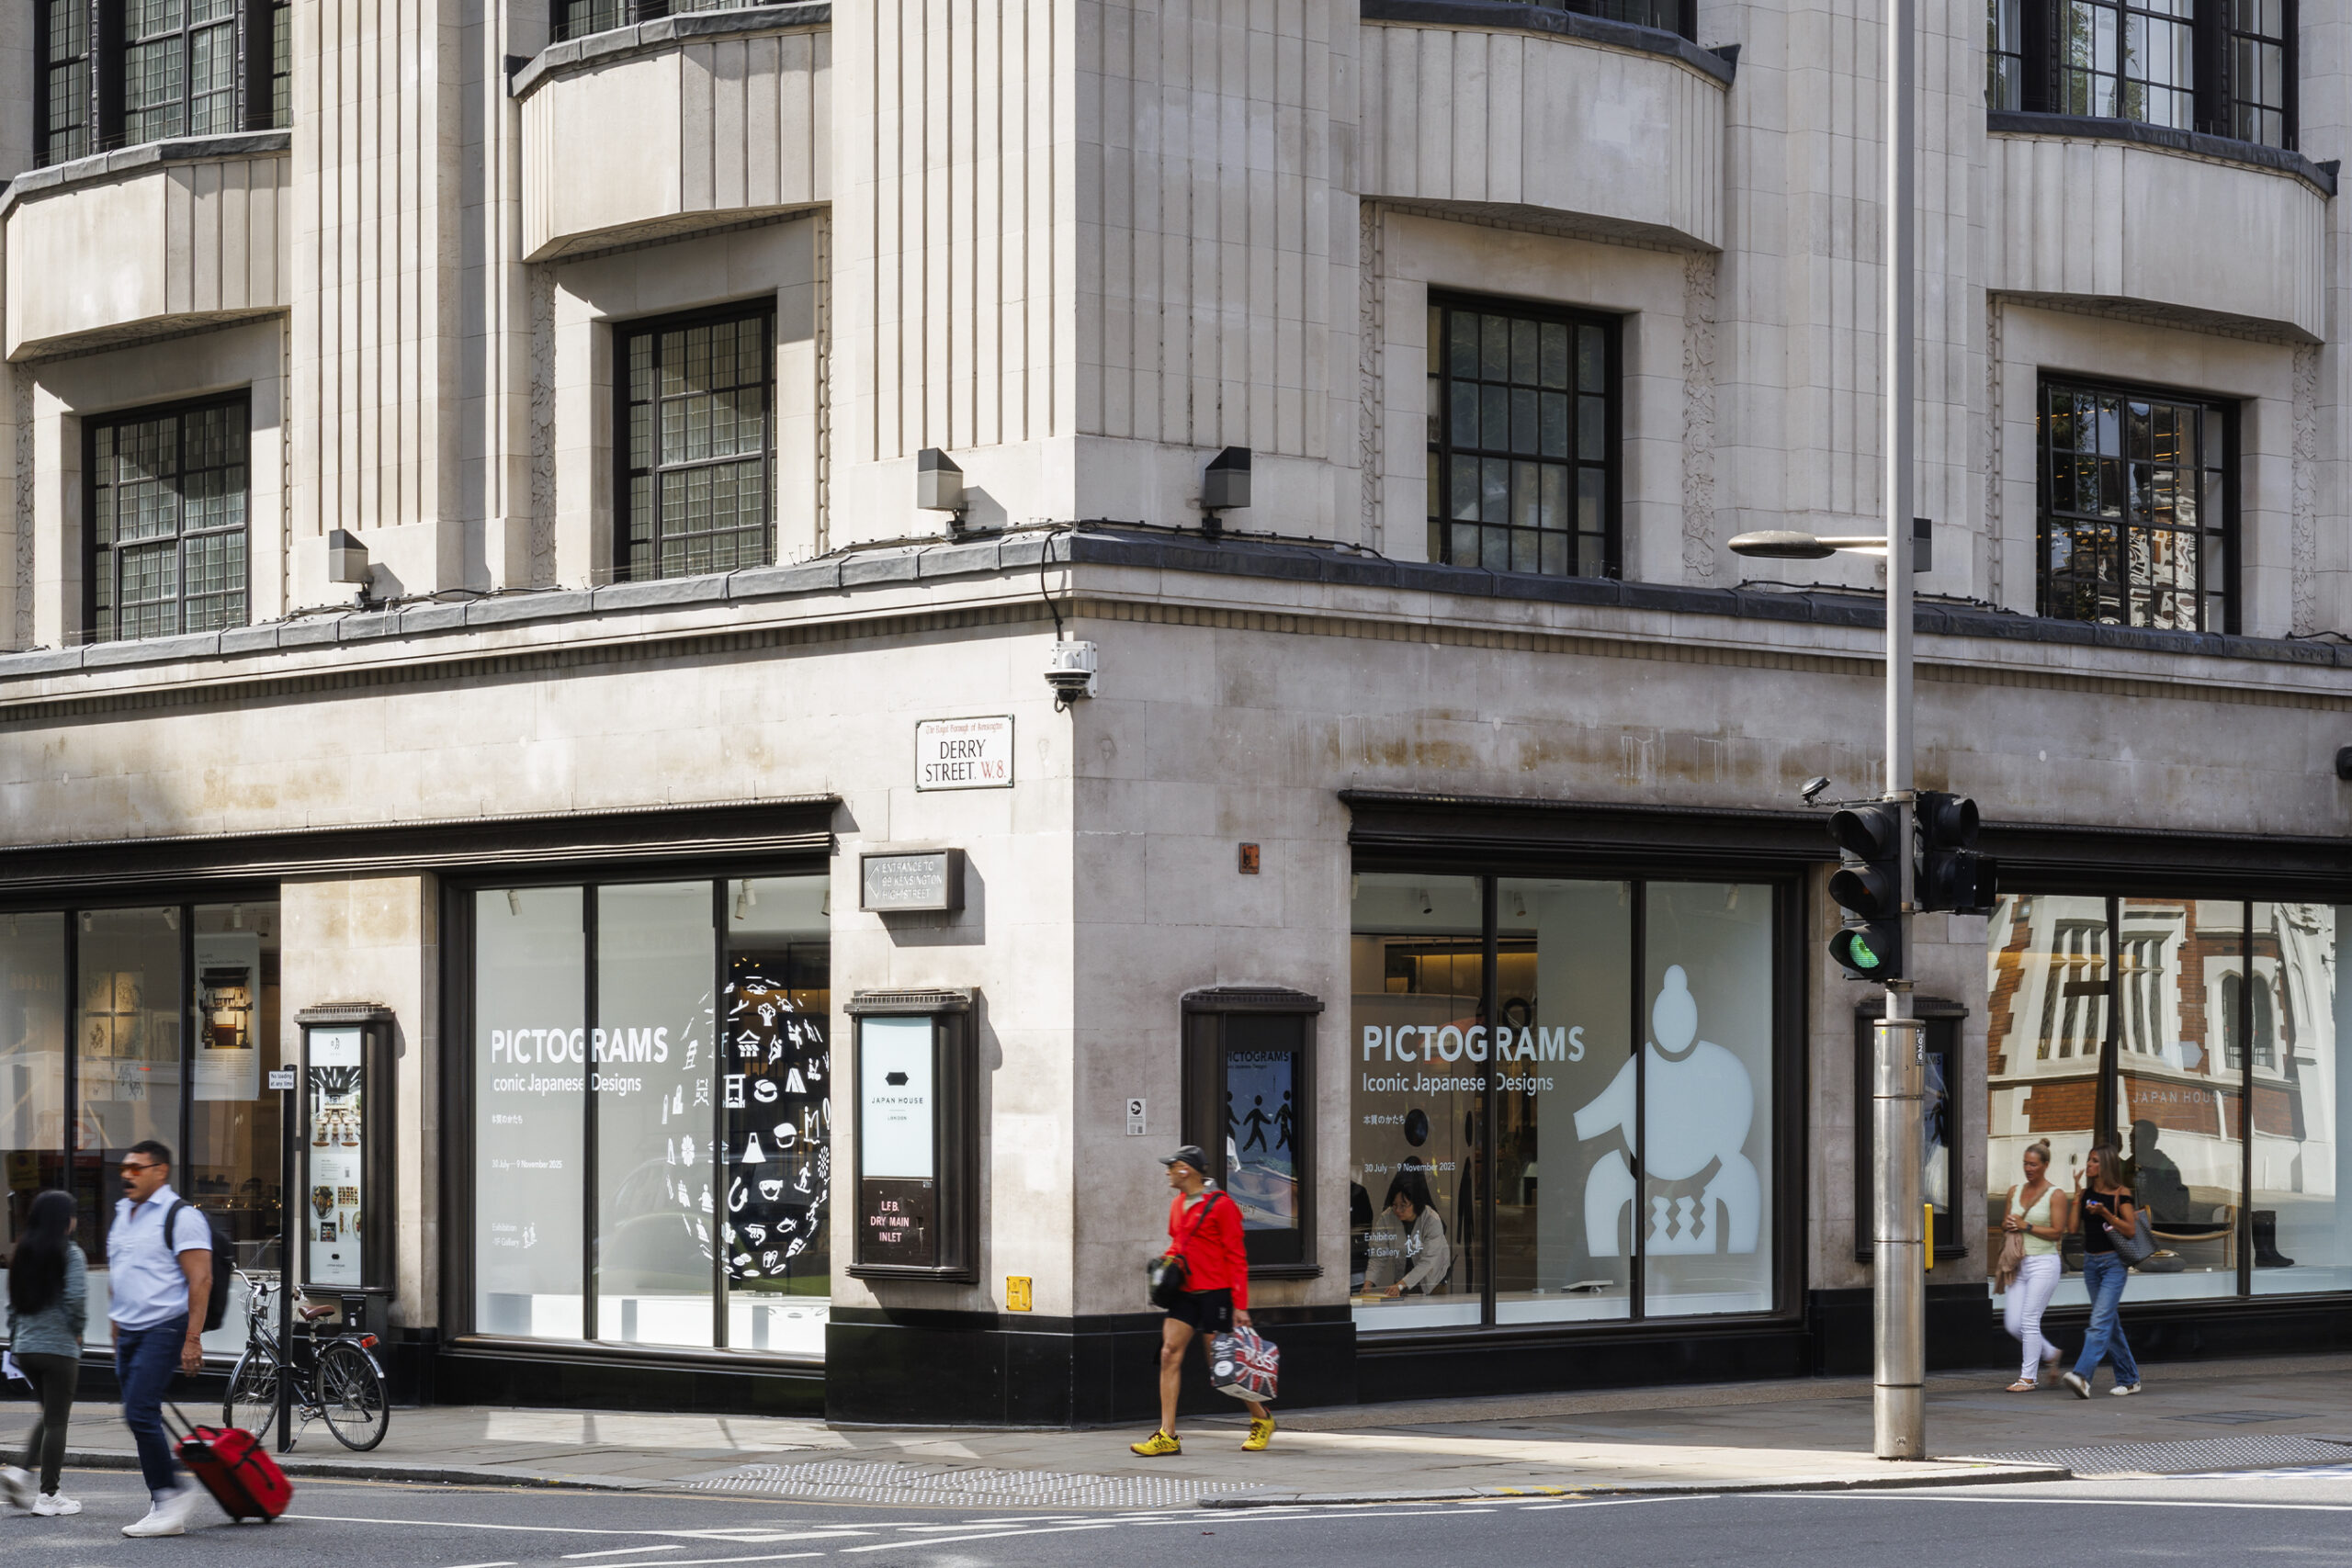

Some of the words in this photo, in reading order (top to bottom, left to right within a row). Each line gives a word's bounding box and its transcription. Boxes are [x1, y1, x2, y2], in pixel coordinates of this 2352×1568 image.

[940, 739, 986, 759] DERRY
[882, 862, 922, 873] ENTRANCE
[923, 861, 934, 872] TO
[882, 876, 892, 886] 99
[894, 874, 943, 886] KENSINGTON
[882, 890, 900, 900] HIGH
[902, 888, 932, 898] STREET
[492, 1027, 669, 1064] PICTOGRAMS
[1363, 1025, 1585, 1062] PICTOGRAMS
[1227, 1051, 1289, 1062] ICTOGRAMS
[527, 1073, 584, 1097] Japanese
[591, 1073, 641, 1097] Designs
[1363, 1073, 1409, 1091] Iconic
[1413, 1073, 1486, 1097] Japanese
[1496, 1073, 1554, 1096] Designs
[2132, 1091, 2177, 1103] JAPAN
[2183, 1091, 2229, 1103] HOUSE
[1363, 1114, 1406, 1125] 本質のかたち
[1364, 1164, 1374, 1173] 30
[1374, 1163, 1387, 1175] July
[1396, 1163, 1403, 1171] 9
[1403, 1162, 1438, 1172] November
[1439, 1161, 1456, 1171] 2025
[870, 1215, 887, 1226] DRY
[888, 1216, 910, 1227] MAIN
[879, 1232, 902, 1243] INLET
[1364, 1232, 1397, 1242] Exhibition
[1376, 1247, 1400, 1258] Gallery
